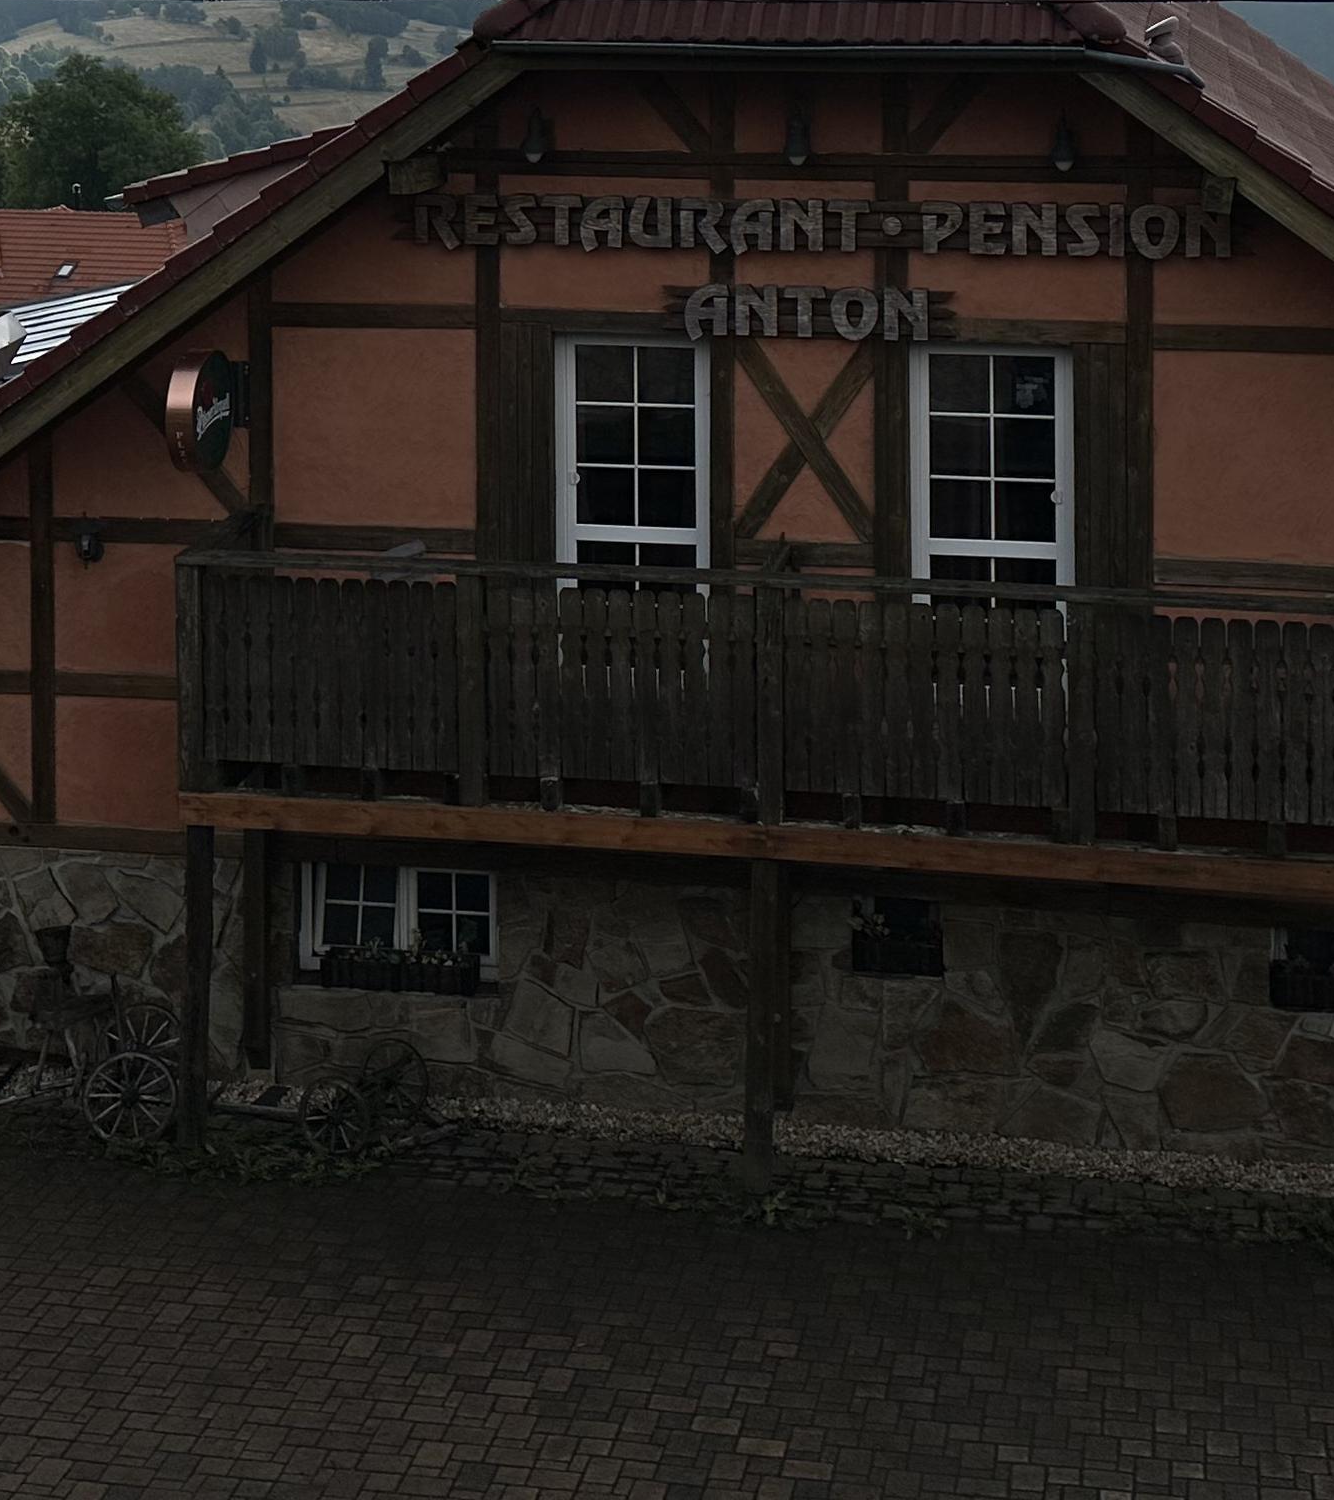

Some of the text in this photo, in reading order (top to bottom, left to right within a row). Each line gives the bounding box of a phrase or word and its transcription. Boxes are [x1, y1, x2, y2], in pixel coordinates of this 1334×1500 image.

[413, 193, 1232, 259] RESTAURANT PENSION
[683, 283, 929, 342] ANTON
